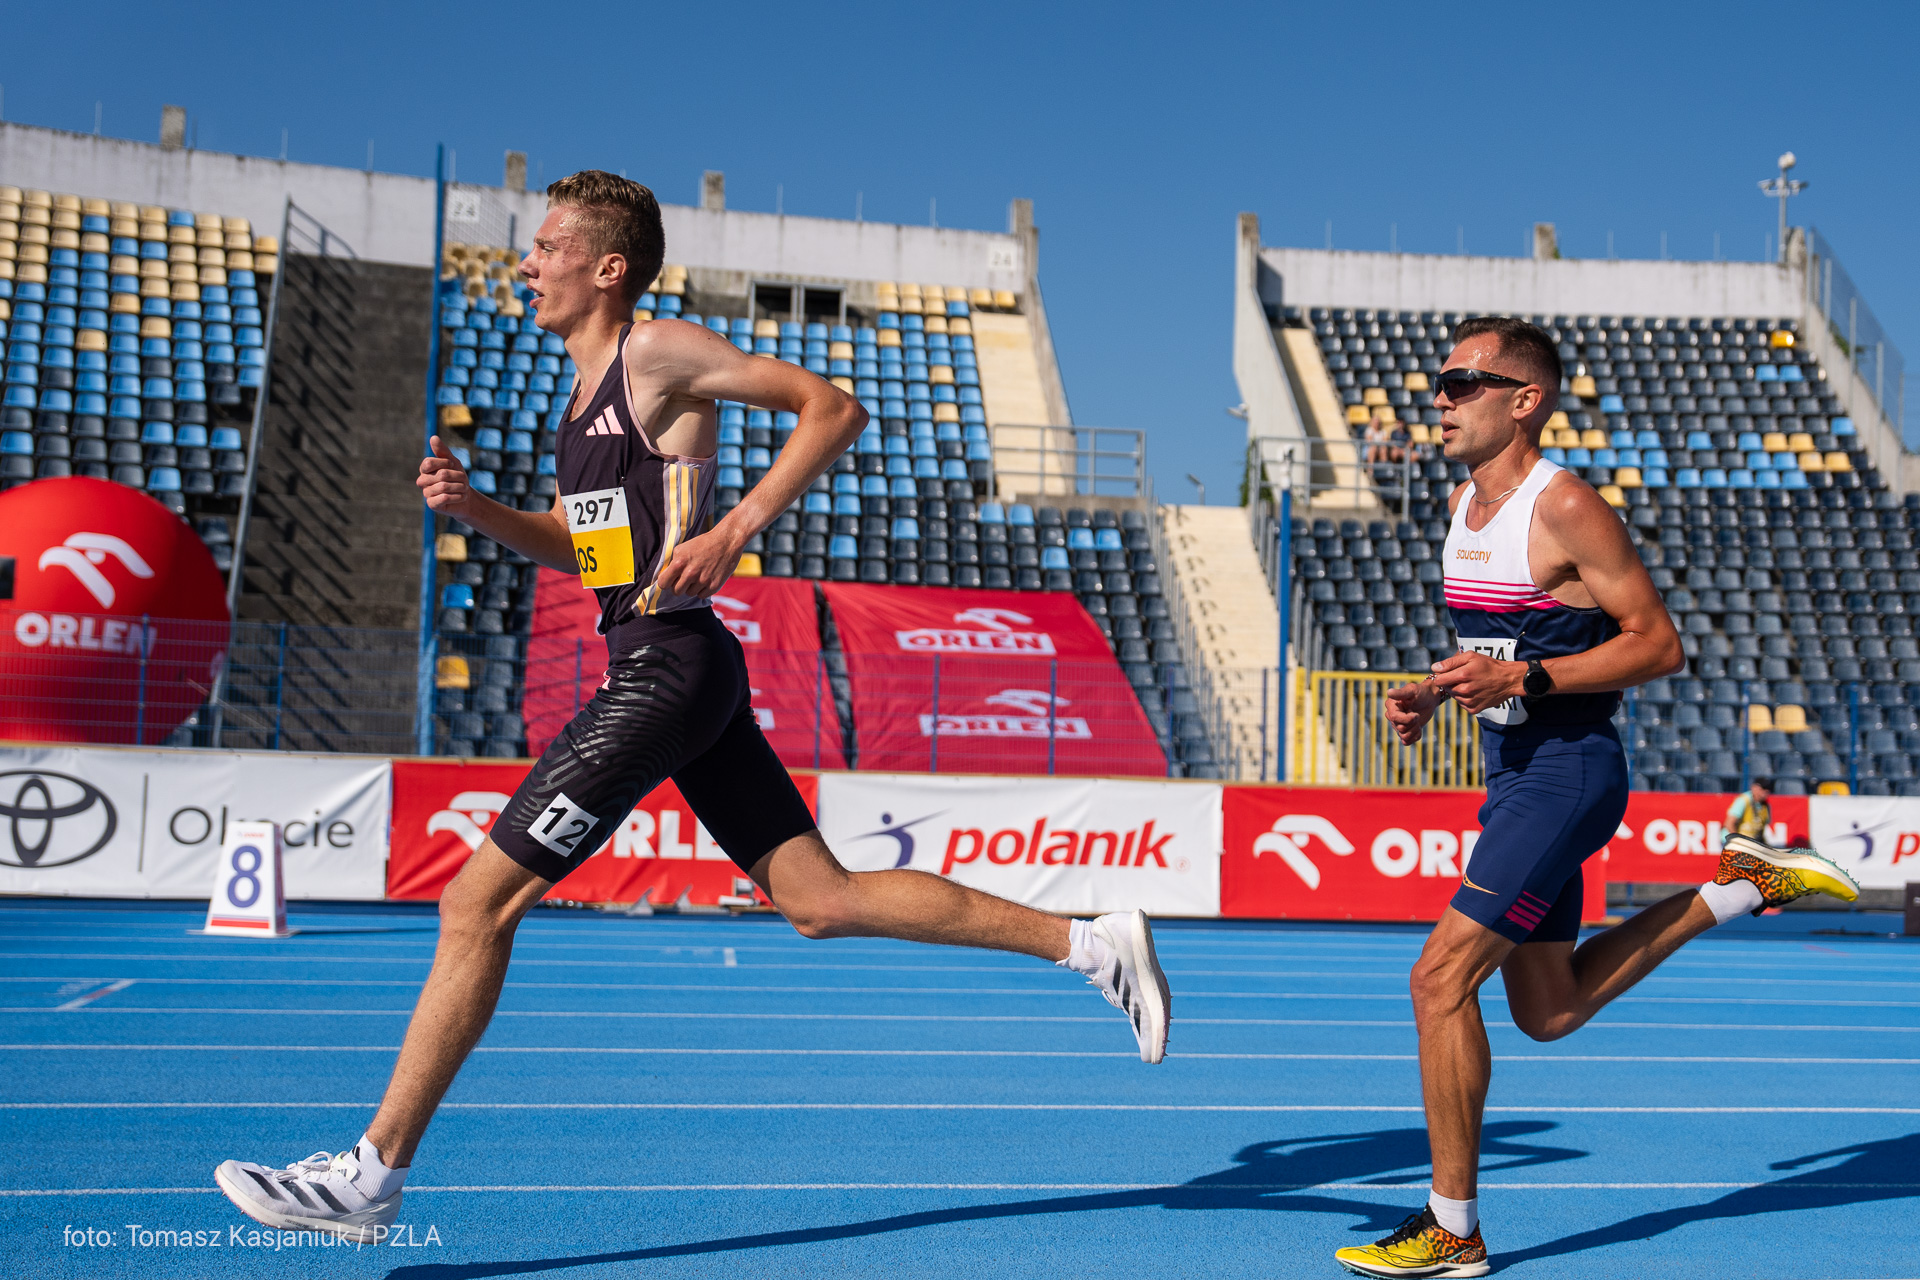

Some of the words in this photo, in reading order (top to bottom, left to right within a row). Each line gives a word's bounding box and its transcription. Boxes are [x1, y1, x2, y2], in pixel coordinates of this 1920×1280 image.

[574, 497, 613, 525] 297
[1456, 549, 1491, 564] saucony
[15, 611, 157, 655] ORLEN
[541, 807, 590, 850] 12
[940, 816, 1176, 876] polanik
[227, 845, 262, 908] 8
